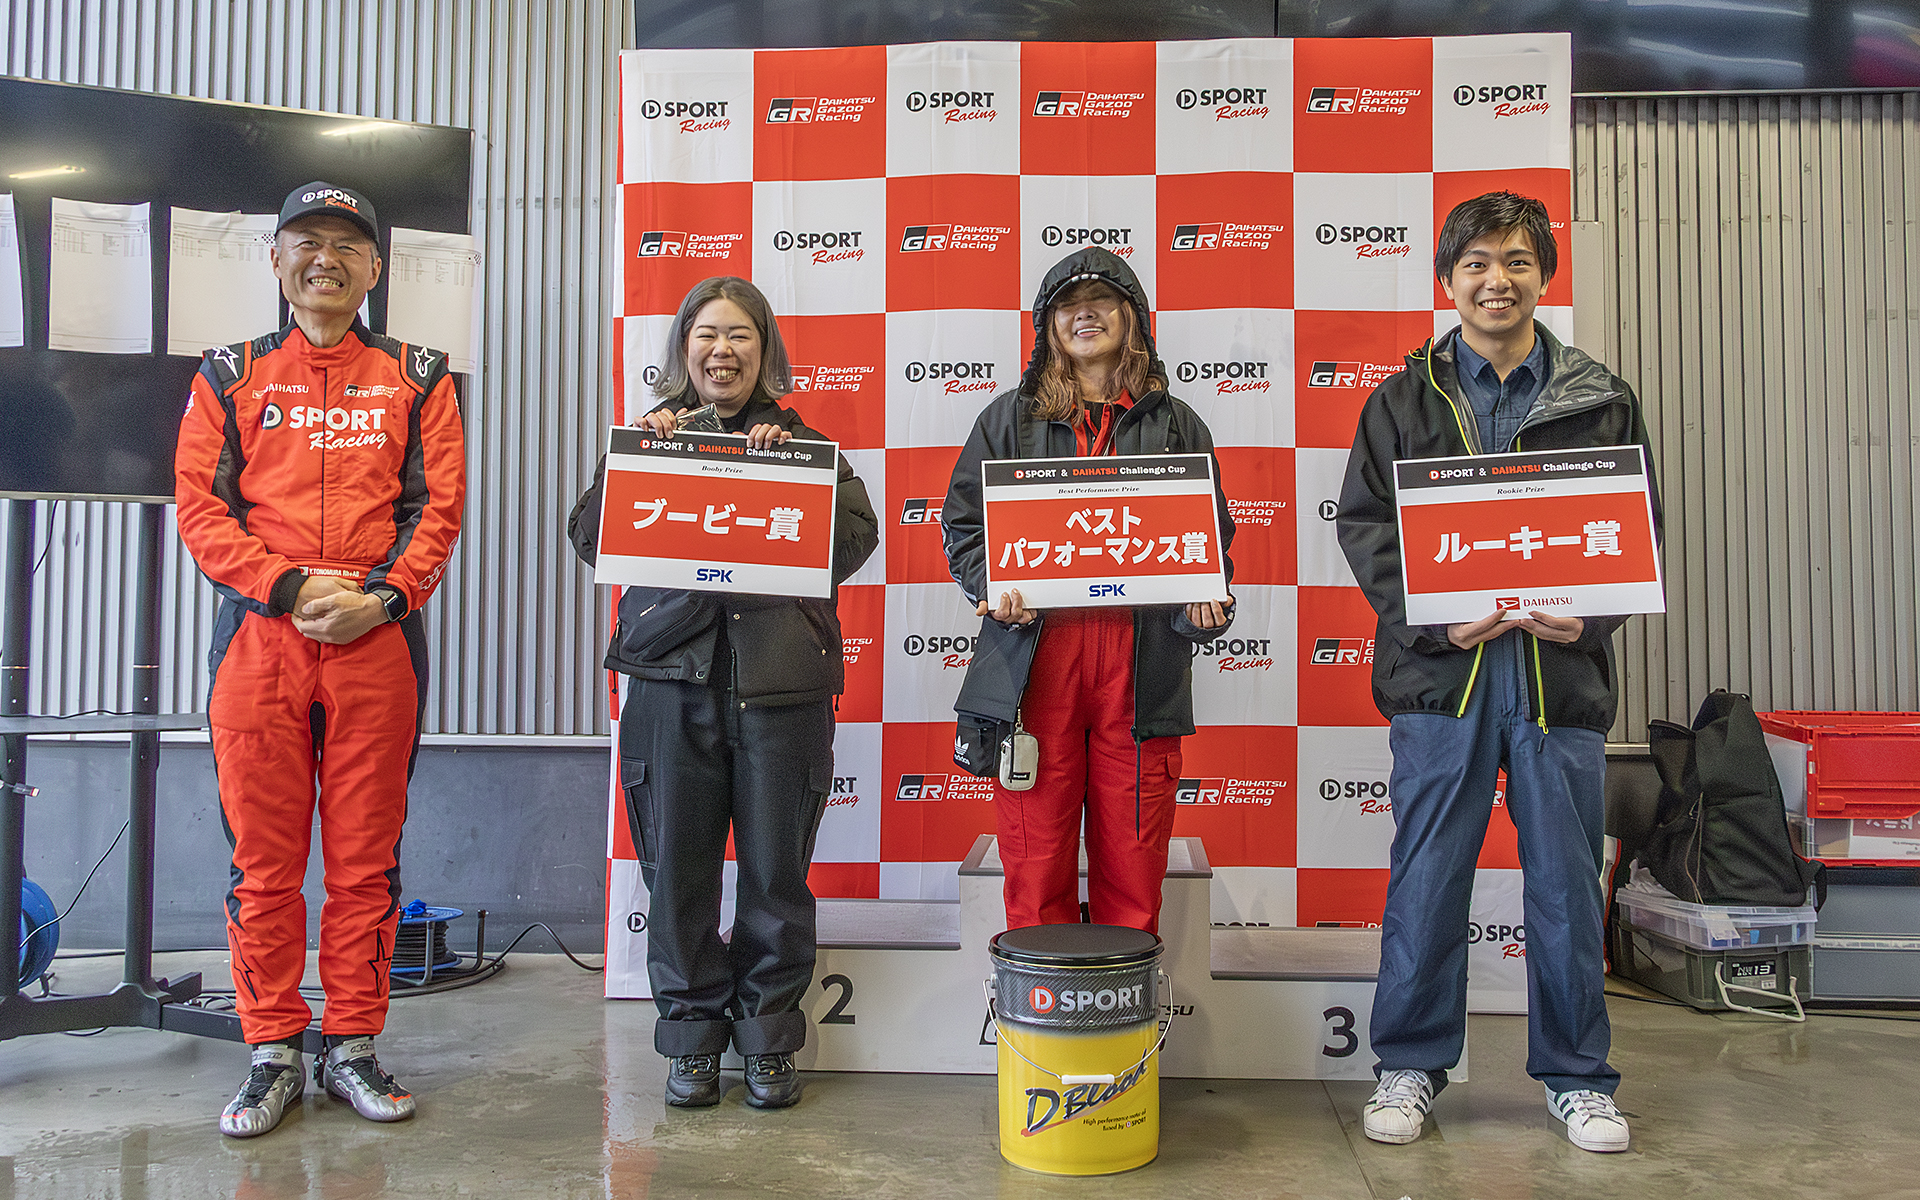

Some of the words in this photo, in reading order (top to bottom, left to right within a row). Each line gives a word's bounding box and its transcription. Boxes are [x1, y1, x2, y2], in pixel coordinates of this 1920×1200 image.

[930, 92, 995, 108] SPORT
[1087, 92, 1145, 100] DAIHATSU
[1200, 88, 1267, 106] SPORT
[1361, 88, 1422, 97] DAIHATSU
[1478, 84, 1546, 102] SPORT
[818, 97, 876, 106] DAIHATSU
[1036, 99, 1081, 118] GR
[1086, 100, 1133, 109] GAZOO
[1310, 95, 1353, 112] GR
[1360, 96, 1408, 106] GAZOO
[664, 101, 728, 118] SPORT
[769, 104, 815, 123] GR
[818, 104, 864, 114] GAZOO
[944, 107, 998, 125] Racing
[1083, 107, 1130, 118] Racing
[1216, 104, 1270, 122] Racing
[1357, 104, 1407, 115] Racing
[1494, 101, 1552, 120] Racing
[815, 112, 862, 122] Racing
[679, 116, 732, 134] Racing
[316, 189, 358, 208] SPORT
[954, 225, 1011, 234] DAIHATSU
[1224, 223, 1284, 232] DAIHATSU
[1340, 225, 1407, 243] SPORT
[690, 232, 744, 242] DAIHATSU
[796, 232, 862, 249] SPORT
[902, 234, 948, 251] GR
[952, 233, 998, 243] GAZOO
[1066, 228, 1131, 244] SPORT
[1174, 232, 1218, 248] GR
[1223, 232, 1272, 240] GAZOO
[641, 240, 683, 257] GR
[686, 241, 733, 250] GAZOO
[950, 241, 996, 252] Racing
[1221, 239, 1270, 250] Racing
[1355, 242, 1412, 260] Racing
[684, 248, 731, 260] Racing
[811, 246, 866, 266] Racing
[818, 366, 874, 374] DAIHATSU
[928, 362, 994, 379] SPORT
[1201, 362, 1268, 379] SPORT
[1364, 364, 1406, 372] DAIHAT
[815, 374, 863, 382] GAZOO
[1311, 372, 1356, 386] GR
[1362, 372, 1392, 380] GAZ
[814, 382, 860, 392] Racing
[944, 380, 998, 396] Racing
[1216, 380, 1272, 396] Racing
[289, 406, 386, 430] SPORT
[308, 430, 388, 450] Racing
[651, 440, 683, 452] SPORT
[687, 444, 694, 452] &
[698, 445, 744, 456] DAIHATSU
[746, 448, 792, 460] Challenge
[794, 450, 812, 462] Cup
[724, 466, 744, 474] Prize
[1025, 468, 1056, 478] SPORT
[1061, 469, 1068, 477] &
[1072, 467, 1118, 476] DAIHATSU
[1120, 466, 1166, 476] Challenge
[1168, 466, 1186, 474] Cup
[1440, 468, 1474, 478] SPORT
[1479, 468, 1487, 476] &
[1492, 464, 1541, 476] DAIHATSU
[1542, 461, 1594, 472] Challenge
[1595, 460, 1616, 470] Cup
[1076, 486, 1120, 494] Performance
[1497, 487, 1523, 495] Rookie
[1525, 486, 1545, 494] Prize
[1228, 500, 1286, 508] DAIHATSU
[1228, 508, 1274, 516] GAZOO
[632, 498, 804, 542] ブービー賞
[1066, 506, 1142, 536] ベスト
[1433, 520, 1622, 564] ルーキー賞
[998, 532, 1209, 569] パフォーマンス賞
[696, 568, 734, 583] SPK
[1088, 583, 1126, 598] SPK
[1523, 596, 1573, 608] DAIHATSU
[927, 636, 978, 653] SPO
[1202, 640, 1270, 656] SPORT
[1314, 649, 1358, 663] GR
[1218, 657, 1274, 673] Racing
[1228, 779, 1286, 787] DAIHATSU
[1344, 781, 1388, 798] SPO
[899, 784, 942, 799] GR
[946, 792, 994, 802] Racing
[1176, 788, 1220, 802] GR
[1226, 788, 1275, 796] GAZOO
[825, 795, 860, 808] cing
[1224, 796, 1272, 806] Racing
[1486, 924, 1526, 942] SPO
[818, 974, 856, 1025] 2
[1029, 986, 1056, 1014] D
[1060, 984, 1142, 1012] SPORT
[1322, 1006, 1358, 1058] 3
[1025, 1088, 1060, 1132] D
[1083, 1118, 1096, 1126] High
[1132, 1117, 1146, 1126] SPORT
